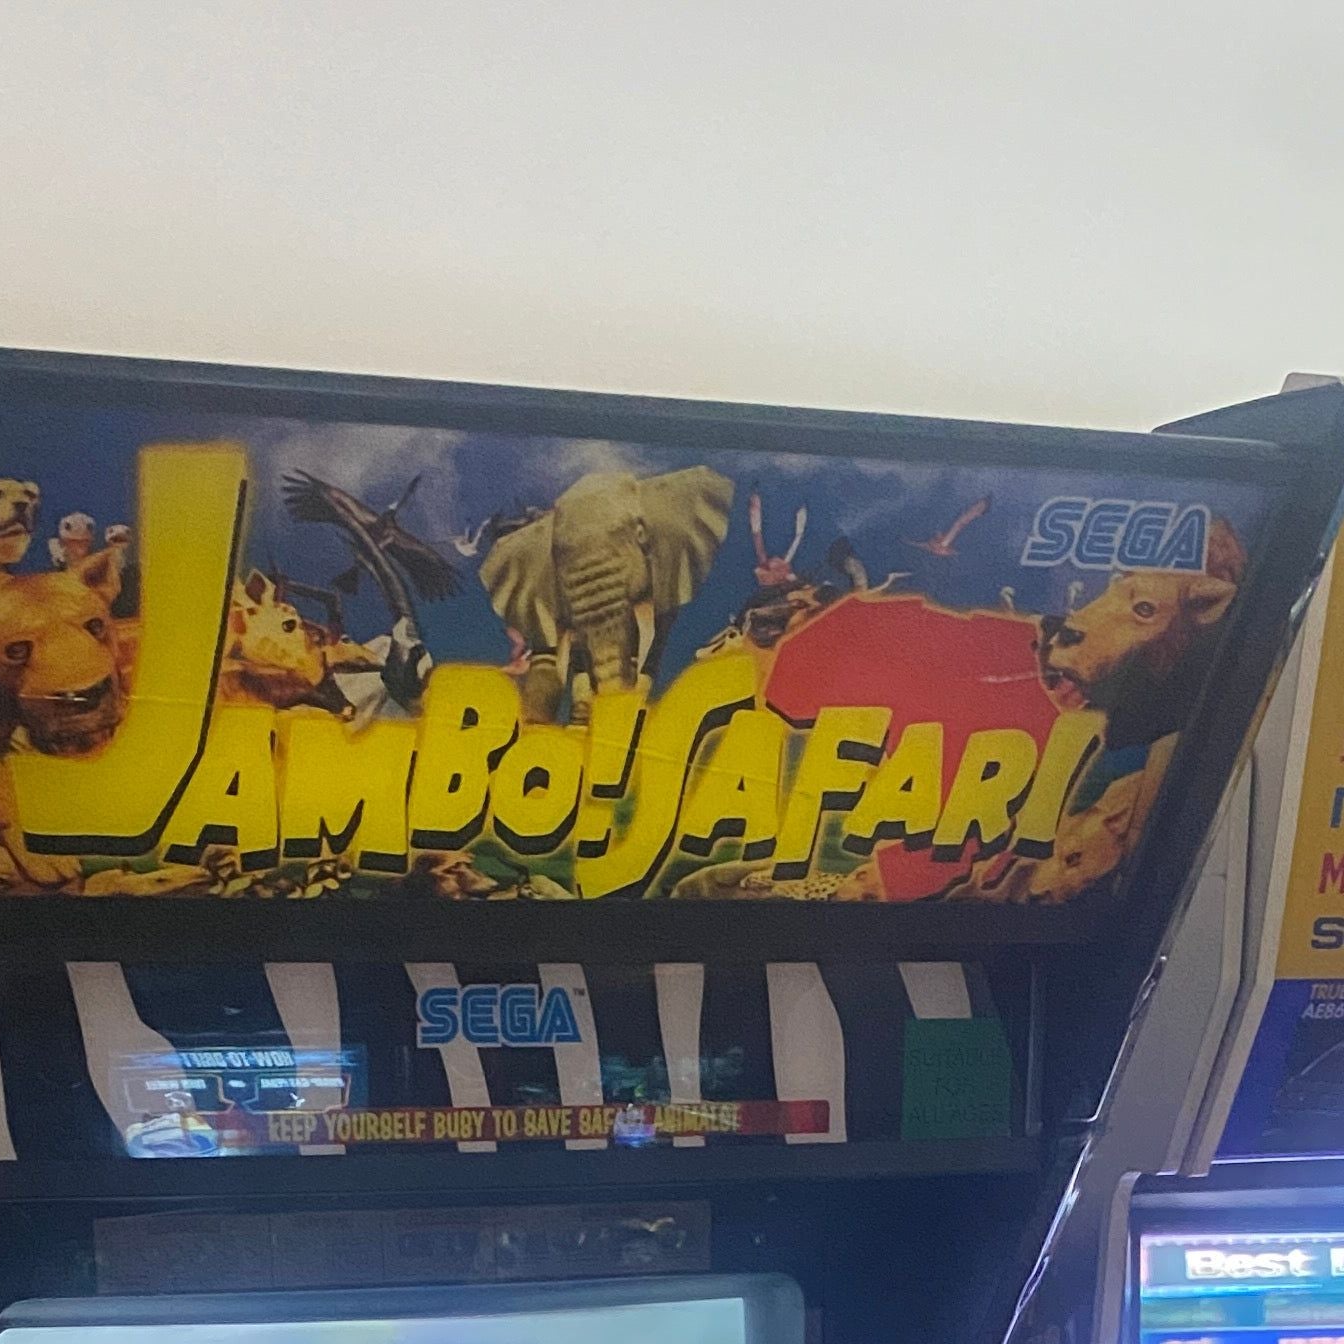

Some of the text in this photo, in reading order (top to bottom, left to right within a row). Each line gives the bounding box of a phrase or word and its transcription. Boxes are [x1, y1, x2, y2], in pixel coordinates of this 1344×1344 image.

[1022, 497, 1212, 572] SEGA
[573, 650, 1108, 900] SAFARI
[416, 983, 586, 1049] SEGA
[267, 1111, 317, 1143] KEEP
[323, 1110, 427, 1142] YOURSELF
[433, 1109, 486, 1139] BUSY
[492, 1109, 517, 1137] TO
[523, 1107, 572, 1137] SAVE
[1184, 1248, 1318, 1280] Best
